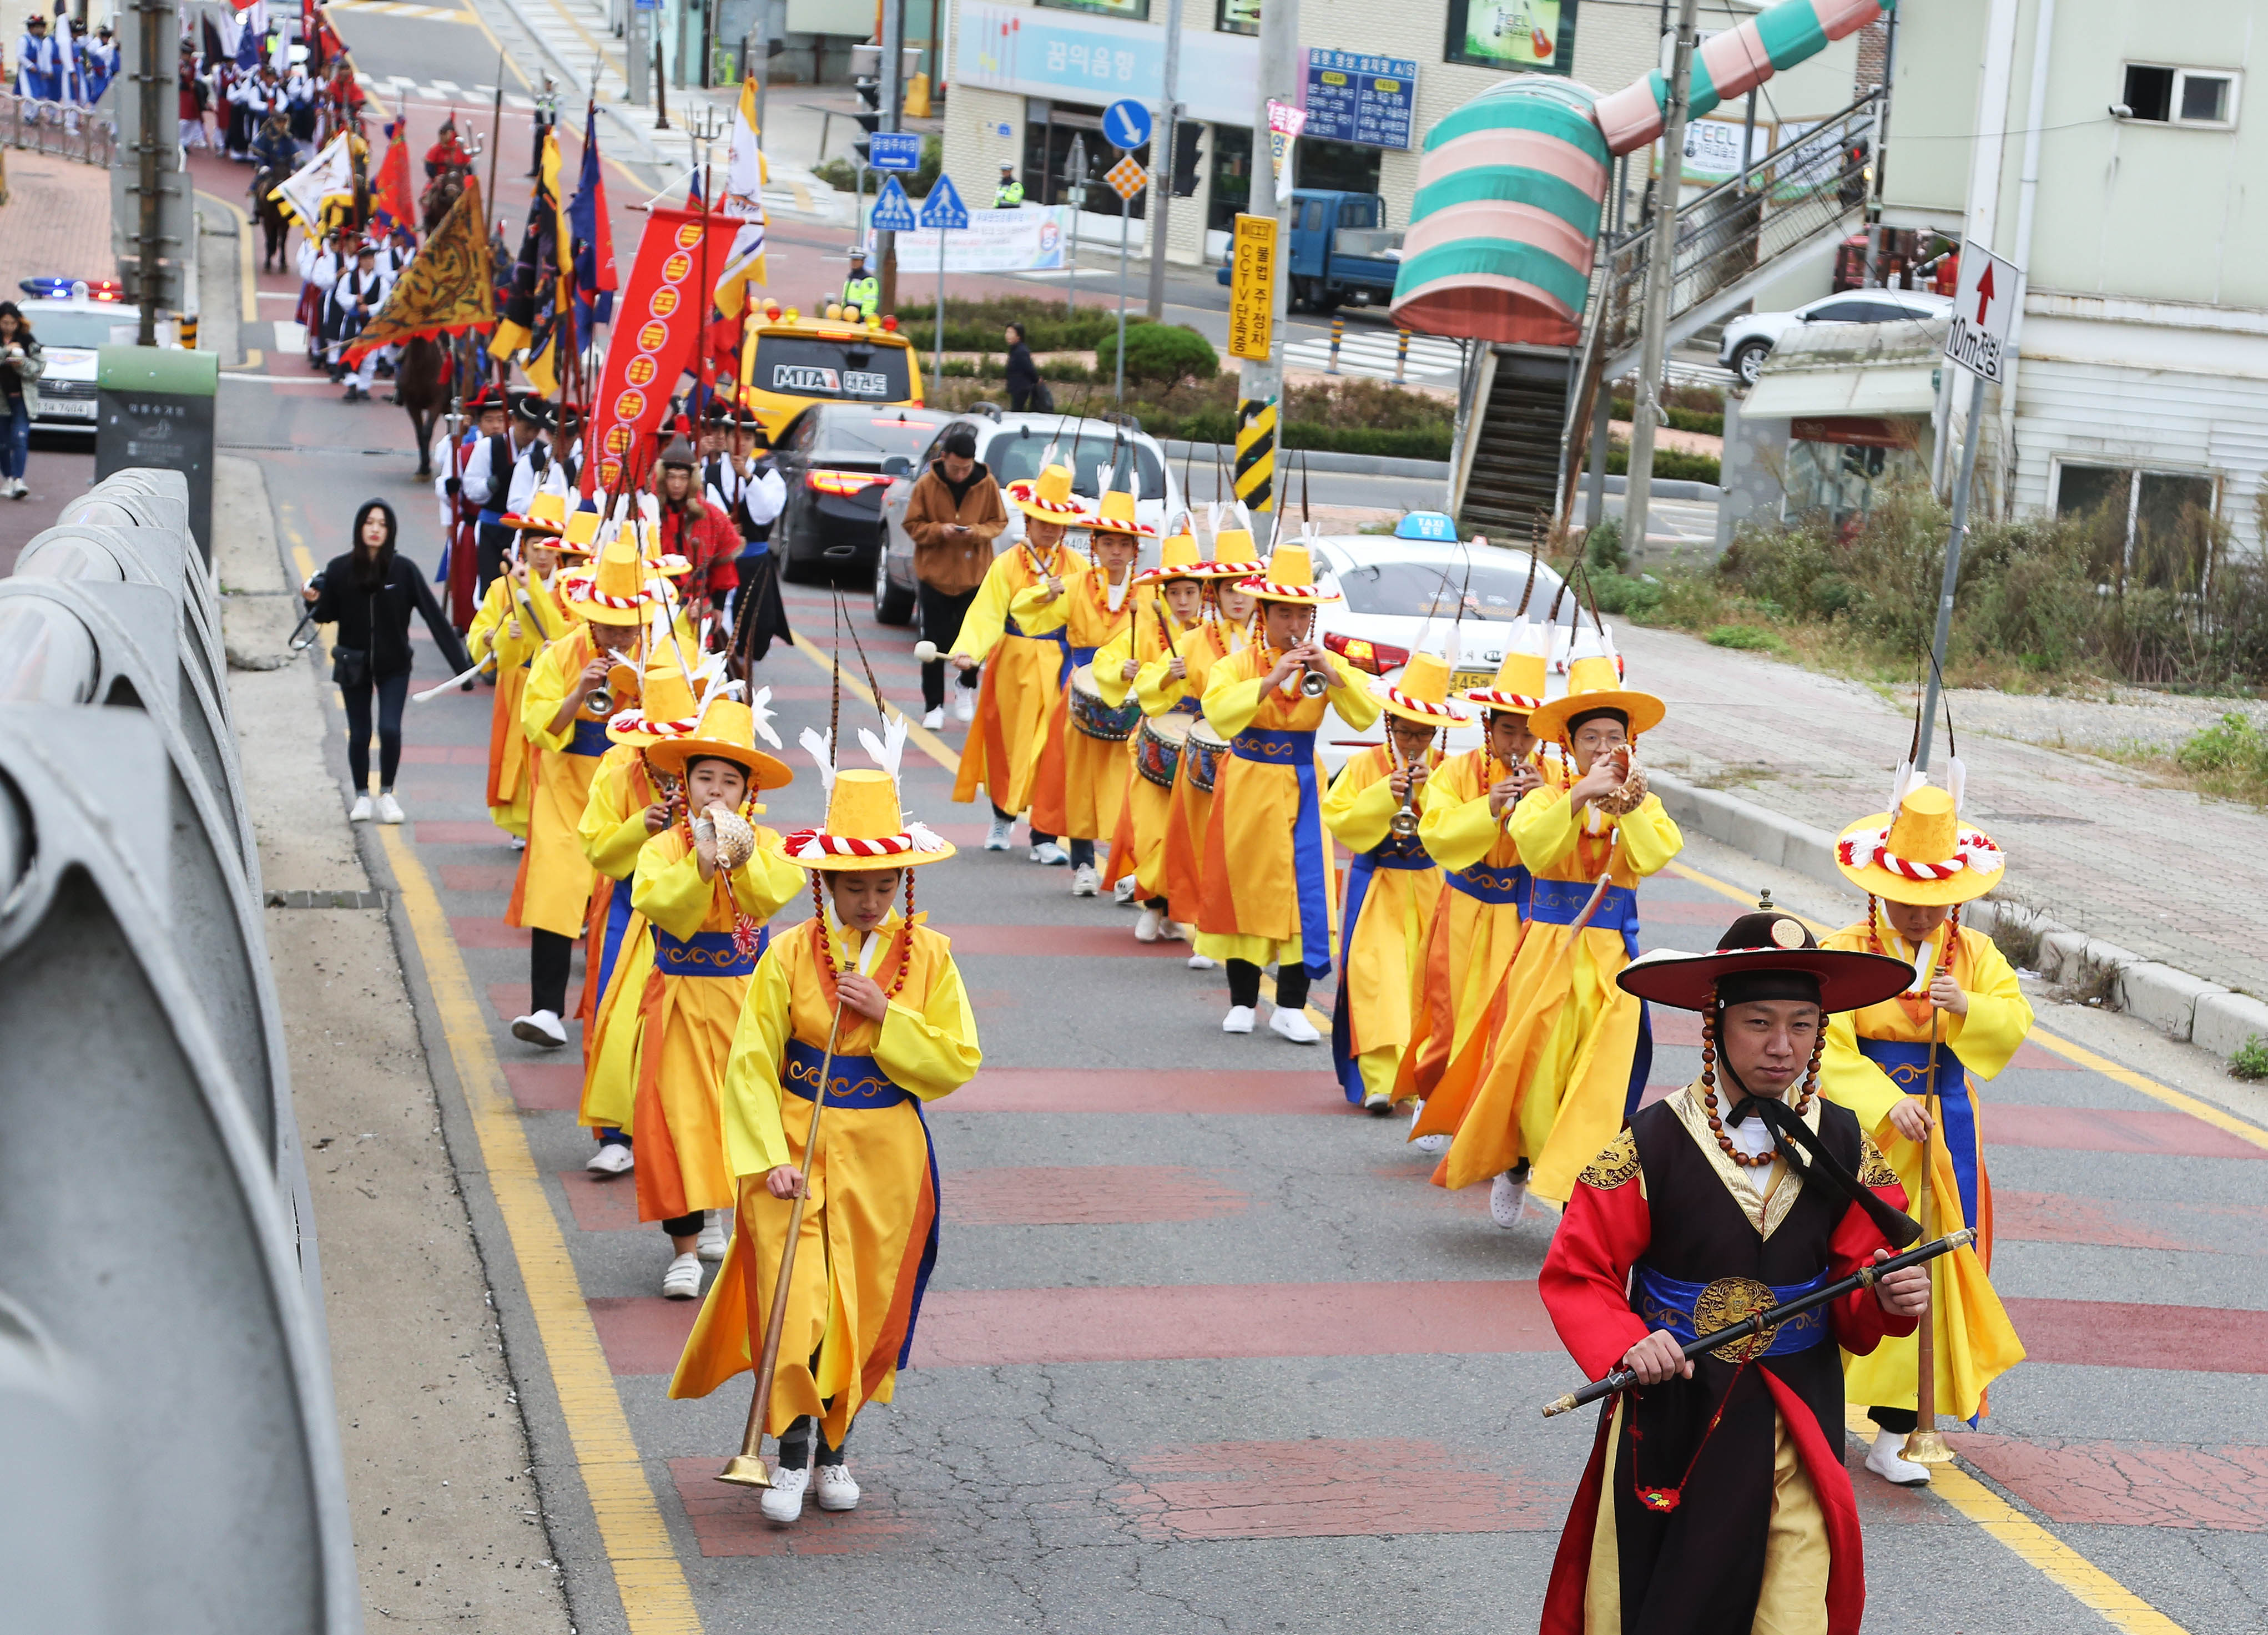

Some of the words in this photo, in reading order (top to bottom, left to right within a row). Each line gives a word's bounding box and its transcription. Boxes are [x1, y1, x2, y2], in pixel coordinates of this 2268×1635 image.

[1047, 41, 1135, 81] 꿈의음향
[1690, 122, 1737, 146] FEEL
[1948, 314, 2002, 376] 10m전방
[774, 365, 835, 391] MIA
[1417, 517, 1445, 528] TAXI
